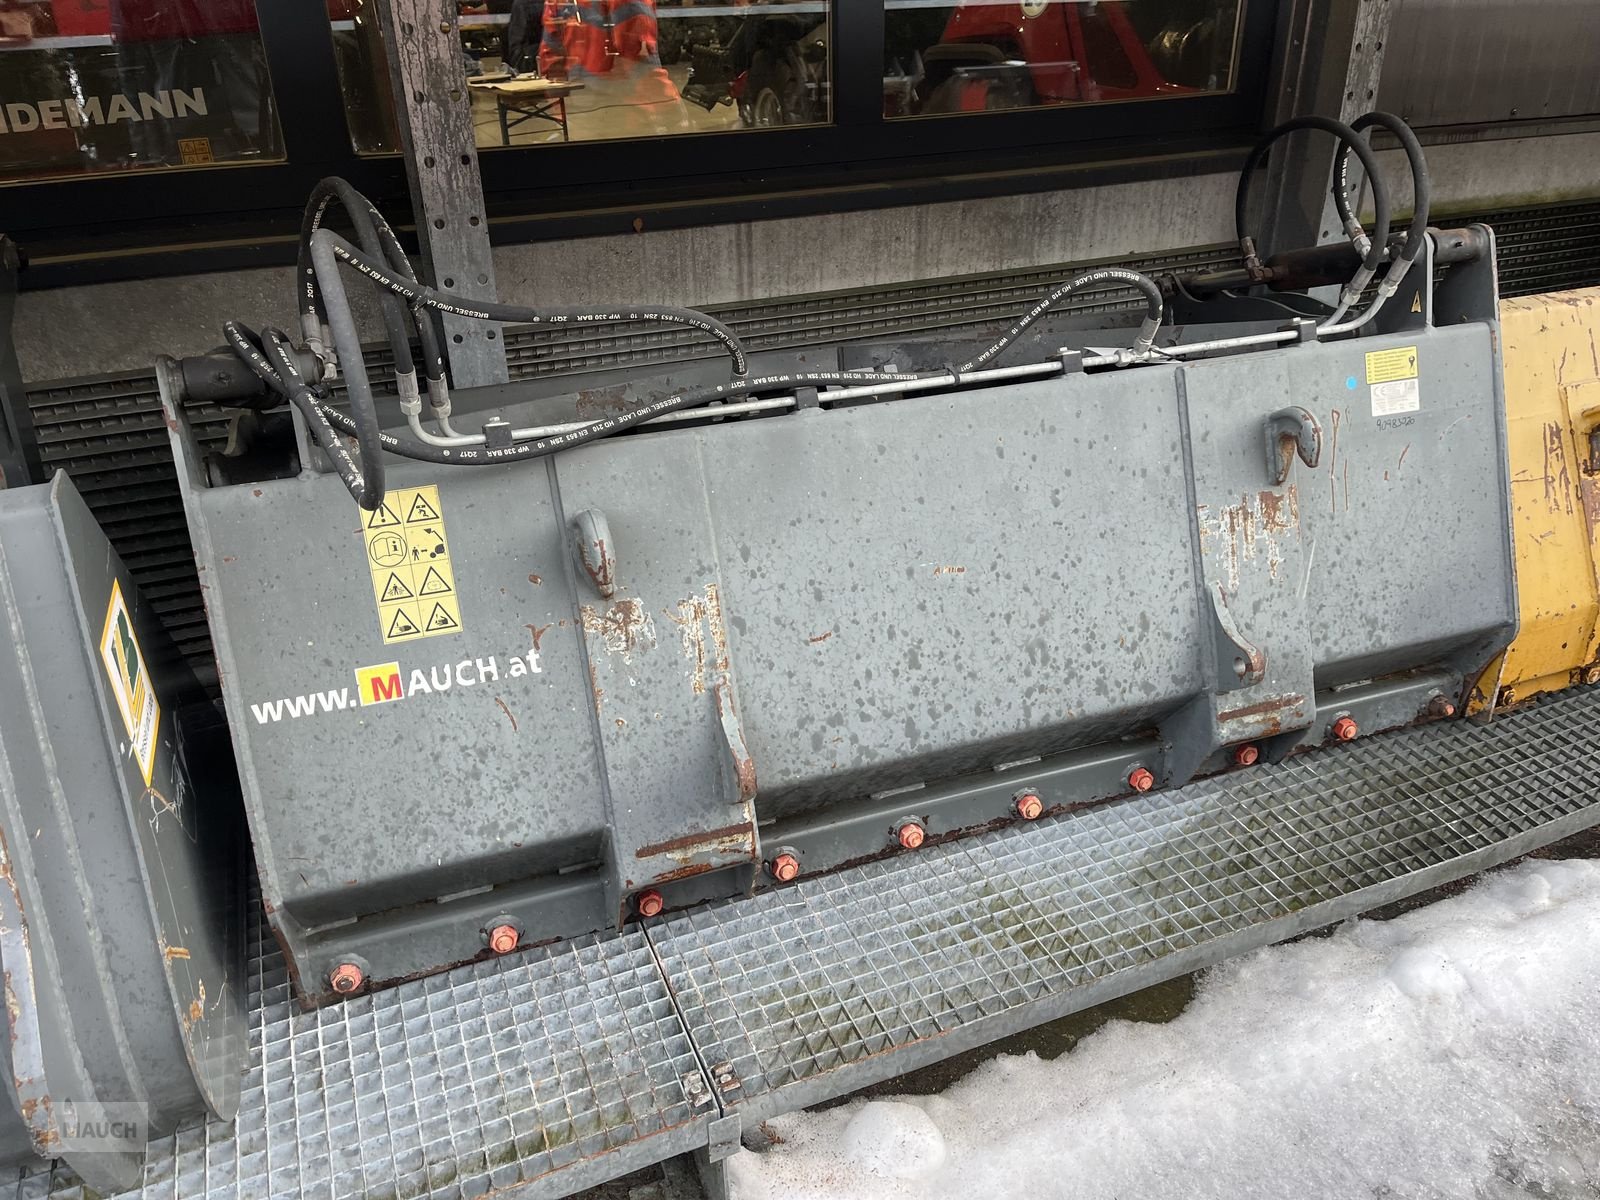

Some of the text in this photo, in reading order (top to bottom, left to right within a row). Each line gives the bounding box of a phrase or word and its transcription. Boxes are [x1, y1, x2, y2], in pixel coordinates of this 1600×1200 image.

[0, 88, 208, 134] DEMANN
[1075, 275, 1093, 287] LADE
[1094, 272, 1108, 280] UND
[1109, 271, 1140, 282] BRESSEL
[391, 283, 403, 292] 210
[1062, 284, 1071, 293] HD
[403, 288, 414, 298] HD
[1052, 290, 1062, 299] 210
[437, 302, 454, 312] UND
[1041, 300, 1049, 310] EN
[455, 306, 490, 319] BRESSEL
[1031, 306, 1042, 317] 853
[700, 322, 711, 330] HD
[1020, 315, 1031, 327] 2SN
[999, 337, 1008, 347] WP
[989, 344, 1000, 354] 330
[978, 351, 991, 362] BAR
[960, 362, 973, 372] 2Q17
[650, 396, 682, 410] BRESSEL
[322, 406, 344, 420] LADE
[636, 408, 651, 417] UND
[618, 412, 637, 424] LADE
[592, 424, 604, 433] 210
[604, 420, 615, 428] HD
[565, 432, 578, 441] 853
[579, 429, 589, 437] EN
[550, 437, 564, 446] 2SN
[487, 449, 503, 457] BAR
[518, 445, 530, 454] WP
[250, 648, 542, 724] www.MAUCH.at
